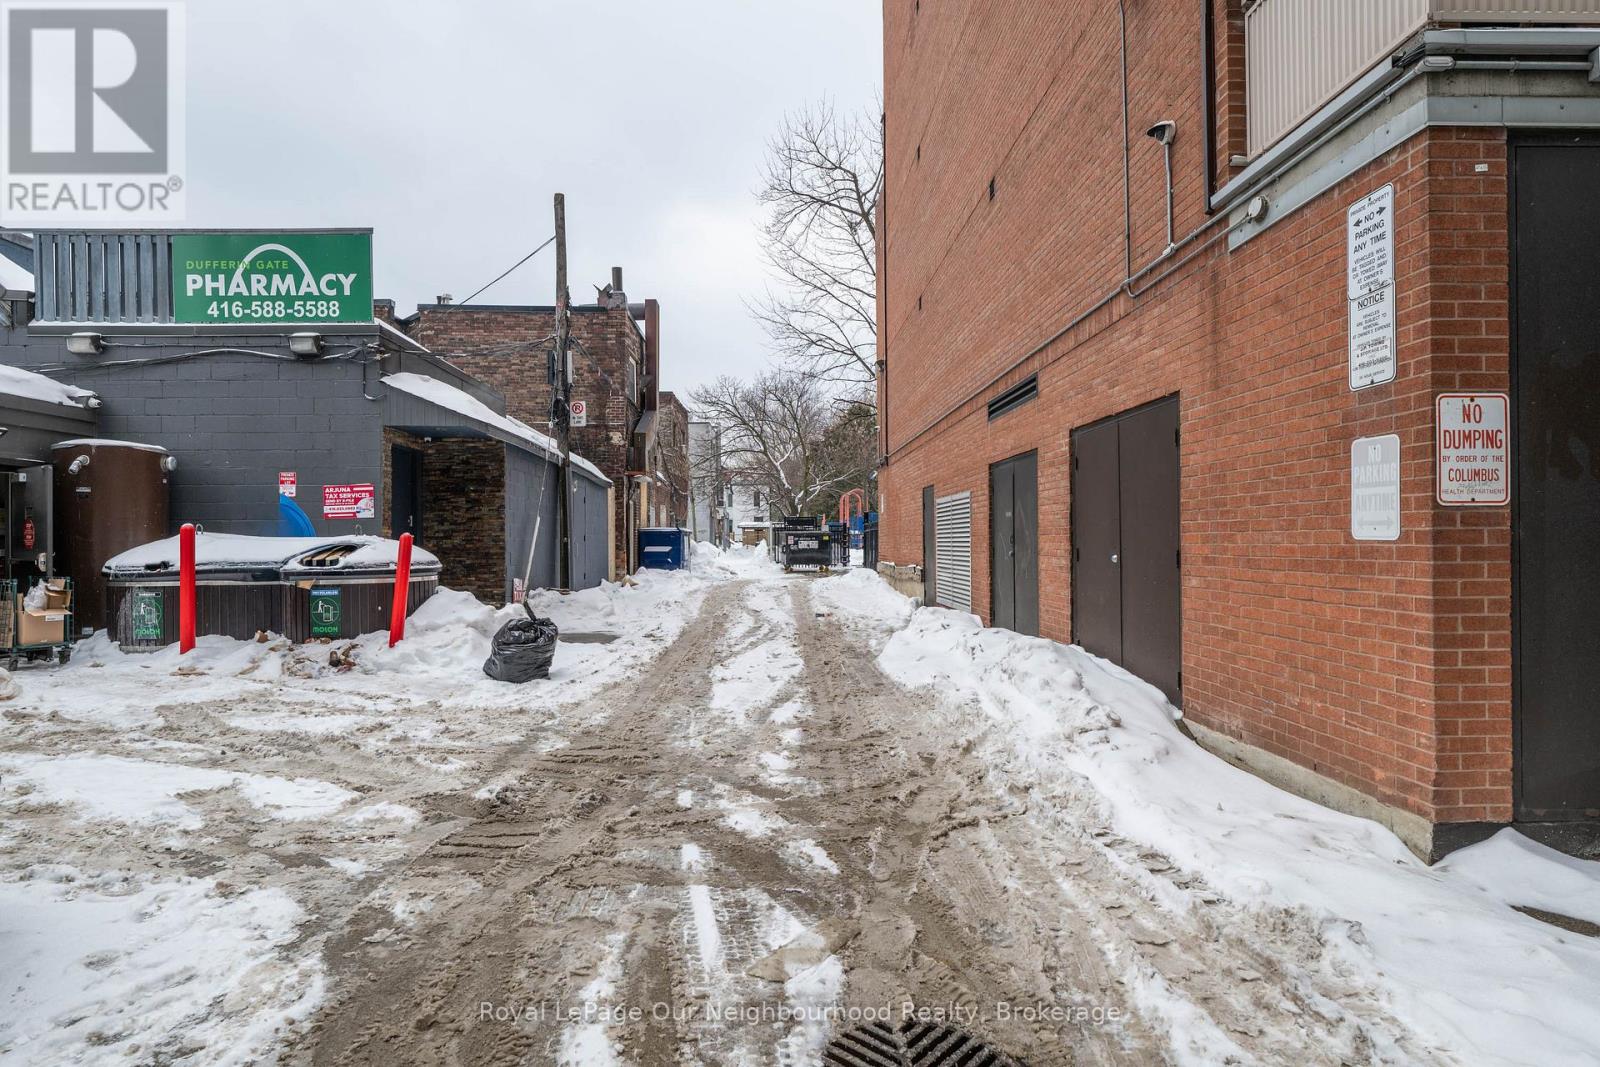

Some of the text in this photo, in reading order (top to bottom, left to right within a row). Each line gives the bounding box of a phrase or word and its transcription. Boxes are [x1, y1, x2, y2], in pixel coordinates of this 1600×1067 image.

[1367, 191, 1390, 207] PROPERTY
[1364, 211, 1375, 224] NO
[1354, 219, 1385, 241] PARKING
[1353, 231, 1387, 254] ANY TIME
[186, 260, 289, 270] DUFFERIN GATE
[1354, 251, 1374, 265] VEHICLES
[186, 273, 357, 296] PHARMACY
[1357, 290, 1385, 308] NOTICE
[207, 301, 340, 318] 416-588-5588
[1462, 403, 1482, 424] NO
[1443, 429, 1503, 449] DUMPING
[1368, 444, 1382, 463] NO
[1442, 455, 1504, 463] BY ORDER OF THE
[1354, 463, 1397, 483] PARKING
[1448, 468, 1500, 482] COLUMBUS
[1356, 491, 1396, 512] ANYTIME
